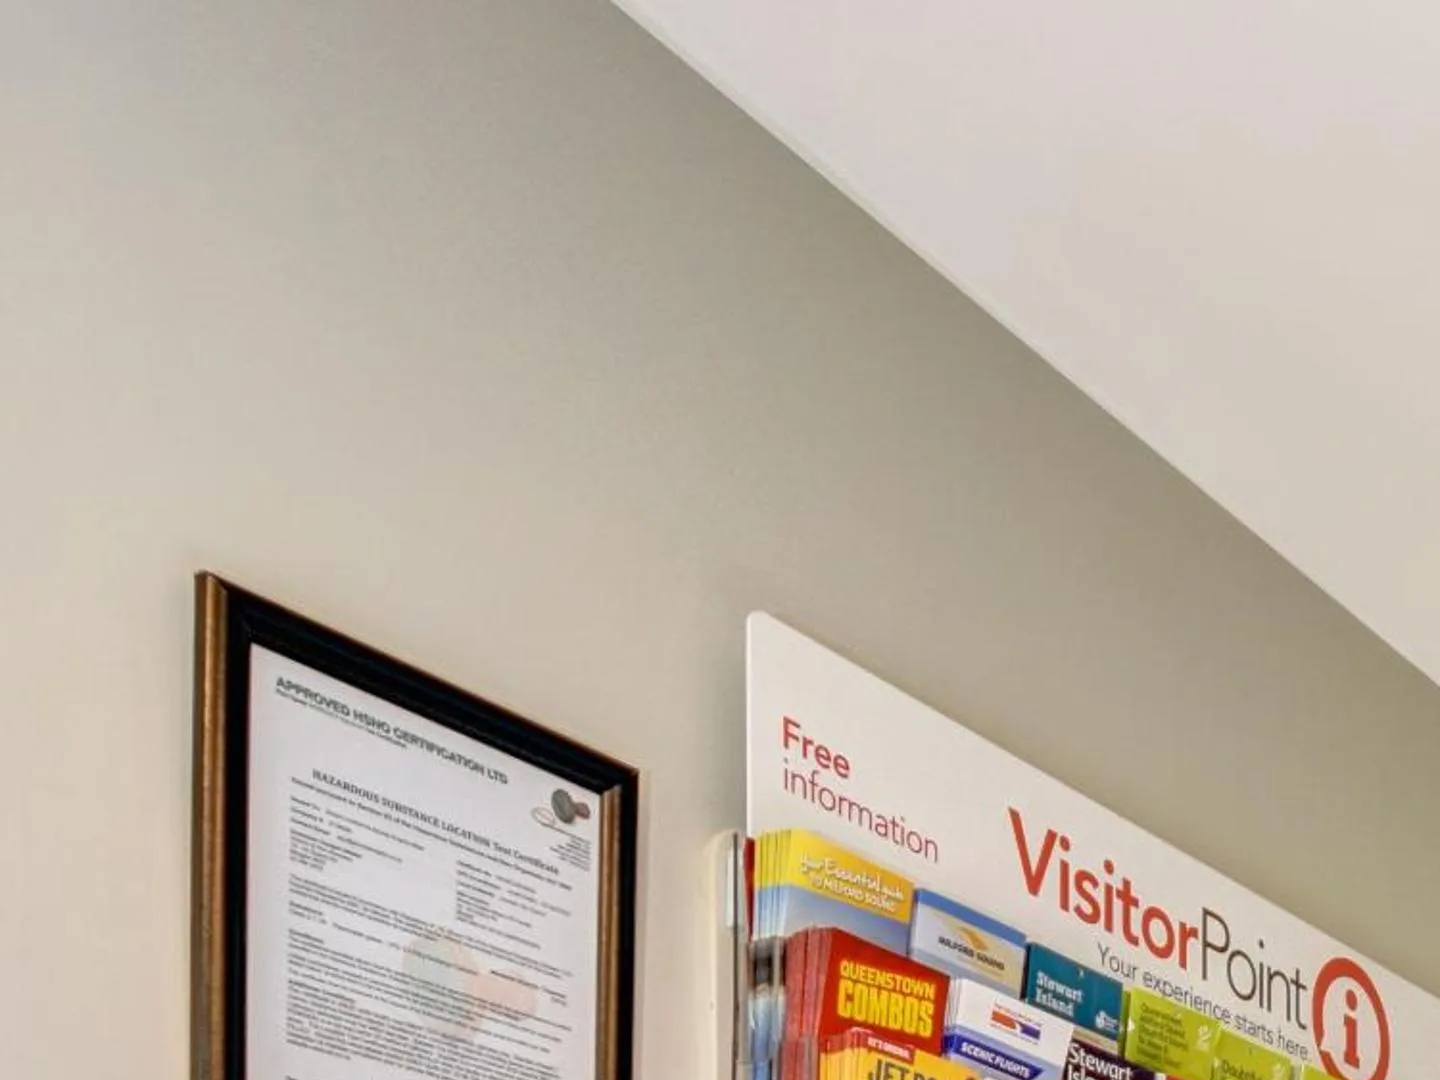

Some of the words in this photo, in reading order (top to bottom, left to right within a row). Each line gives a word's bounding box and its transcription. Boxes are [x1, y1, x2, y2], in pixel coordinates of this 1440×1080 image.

[276, 677, 350, 716] APPROVED
[393, 727, 485, 775] CERTIFICATION
[487, 768, 508, 785] LTD
[781, 716, 850, 780] Free
[312, 769, 380, 803] HAZARDOUS
[382, 797, 440, 827] SUBSTANCE
[441, 821, 490, 847] LOCATION
[781, 760, 939, 864] information
[1008, 807, 1308, 1031] VisitorPoint
[837, 979, 935, 1038] COMBOS
[840, 960, 936, 998] QUEENSTOWN
[1036, 970, 1084, 1002] Stewart
[1036, 989, 1074, 1016] Island
[1098, 944, 1138, 980] Your
[1142, 970, 1233, 1021] experience
[1234, 1014, 1274, 1044] starts
[1278, 1035, 1312, 1062] here.
[962, 1042, 996, 1064] SCENIC
[994, 1053, 1030, 1078] FLIGHTS
